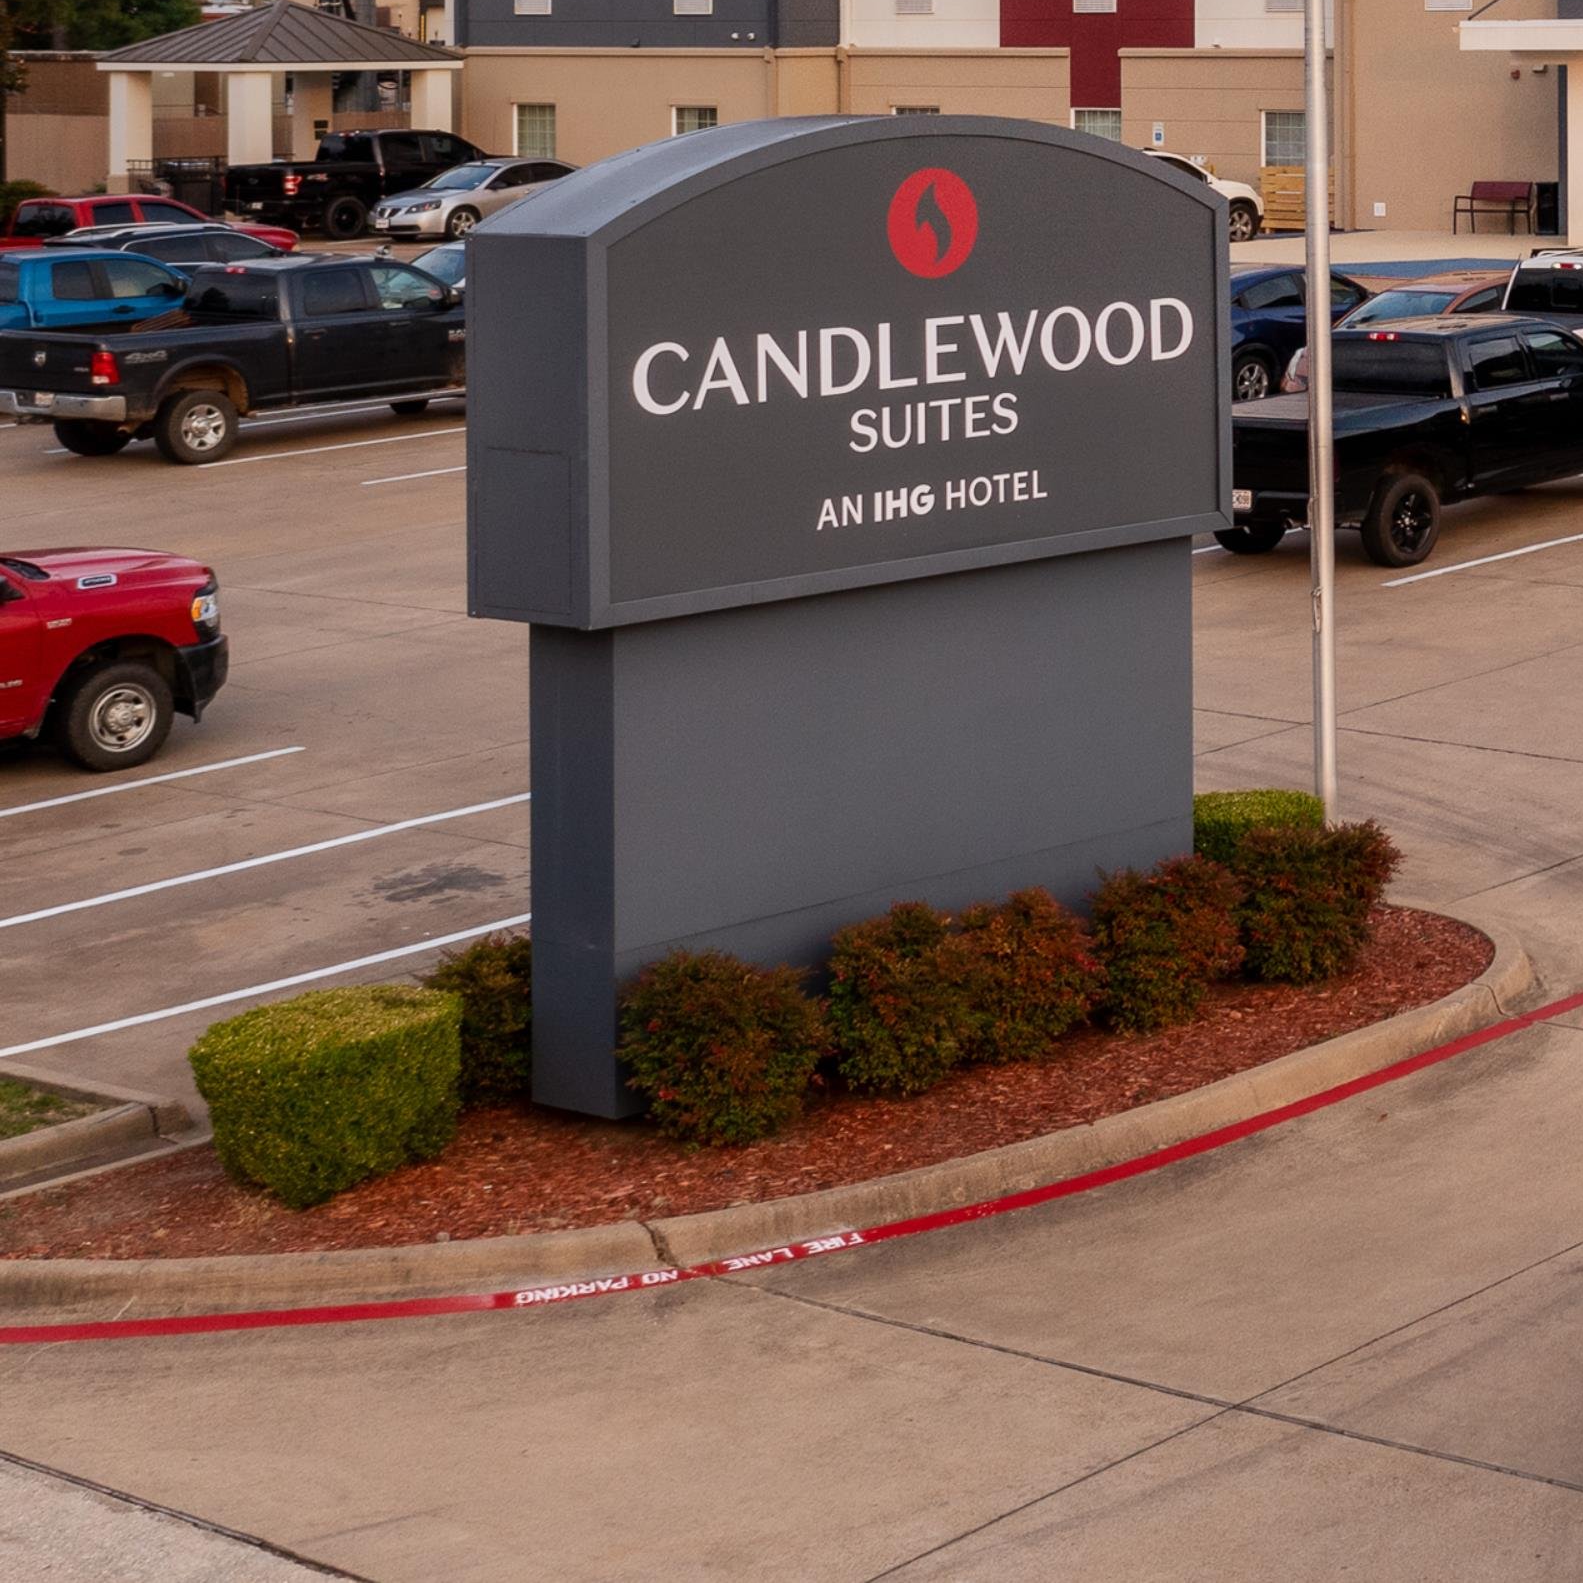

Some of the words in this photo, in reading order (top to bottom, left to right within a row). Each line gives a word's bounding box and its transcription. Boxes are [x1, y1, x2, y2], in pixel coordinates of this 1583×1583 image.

[632, 297, 1194, 415] CANDLEWOOD
[849, 392, 1019, 453] SUITES
[816, 494, 863, 531] AN
[874, 484, 935, 523] IHG
[945, 469, 1048, 511] HOTEL
[801, 1232, 865, 1255] FIRE
[721, 1246, 795, 1271] LANE
[514, 1276, 631, 1305] PARKING
[640, 1269, 680, 1285] NO
